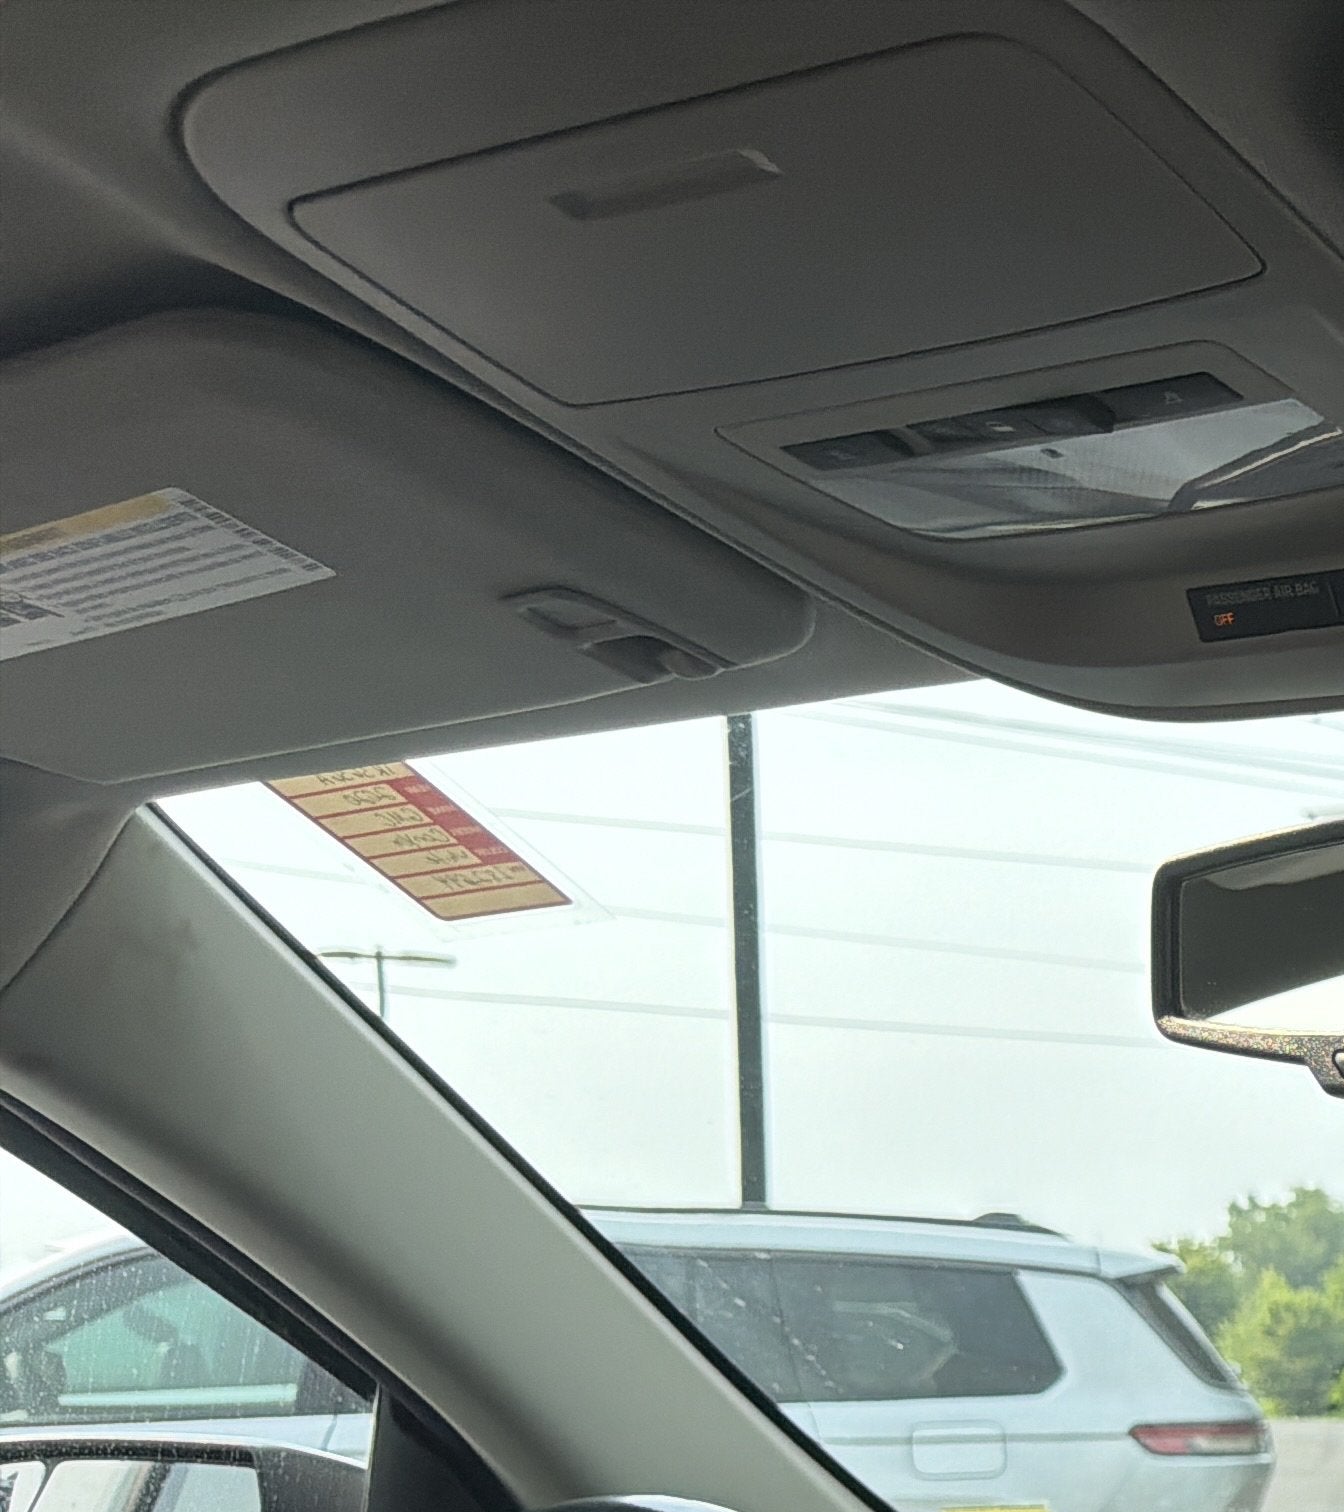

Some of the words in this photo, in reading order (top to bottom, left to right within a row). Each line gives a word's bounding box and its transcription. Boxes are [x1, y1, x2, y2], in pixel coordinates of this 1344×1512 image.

[1274, 586, 1292, 599] AIR
[1296, 581, 1320, 596] BAG
[1214, 612, 1235, 626] OFF
